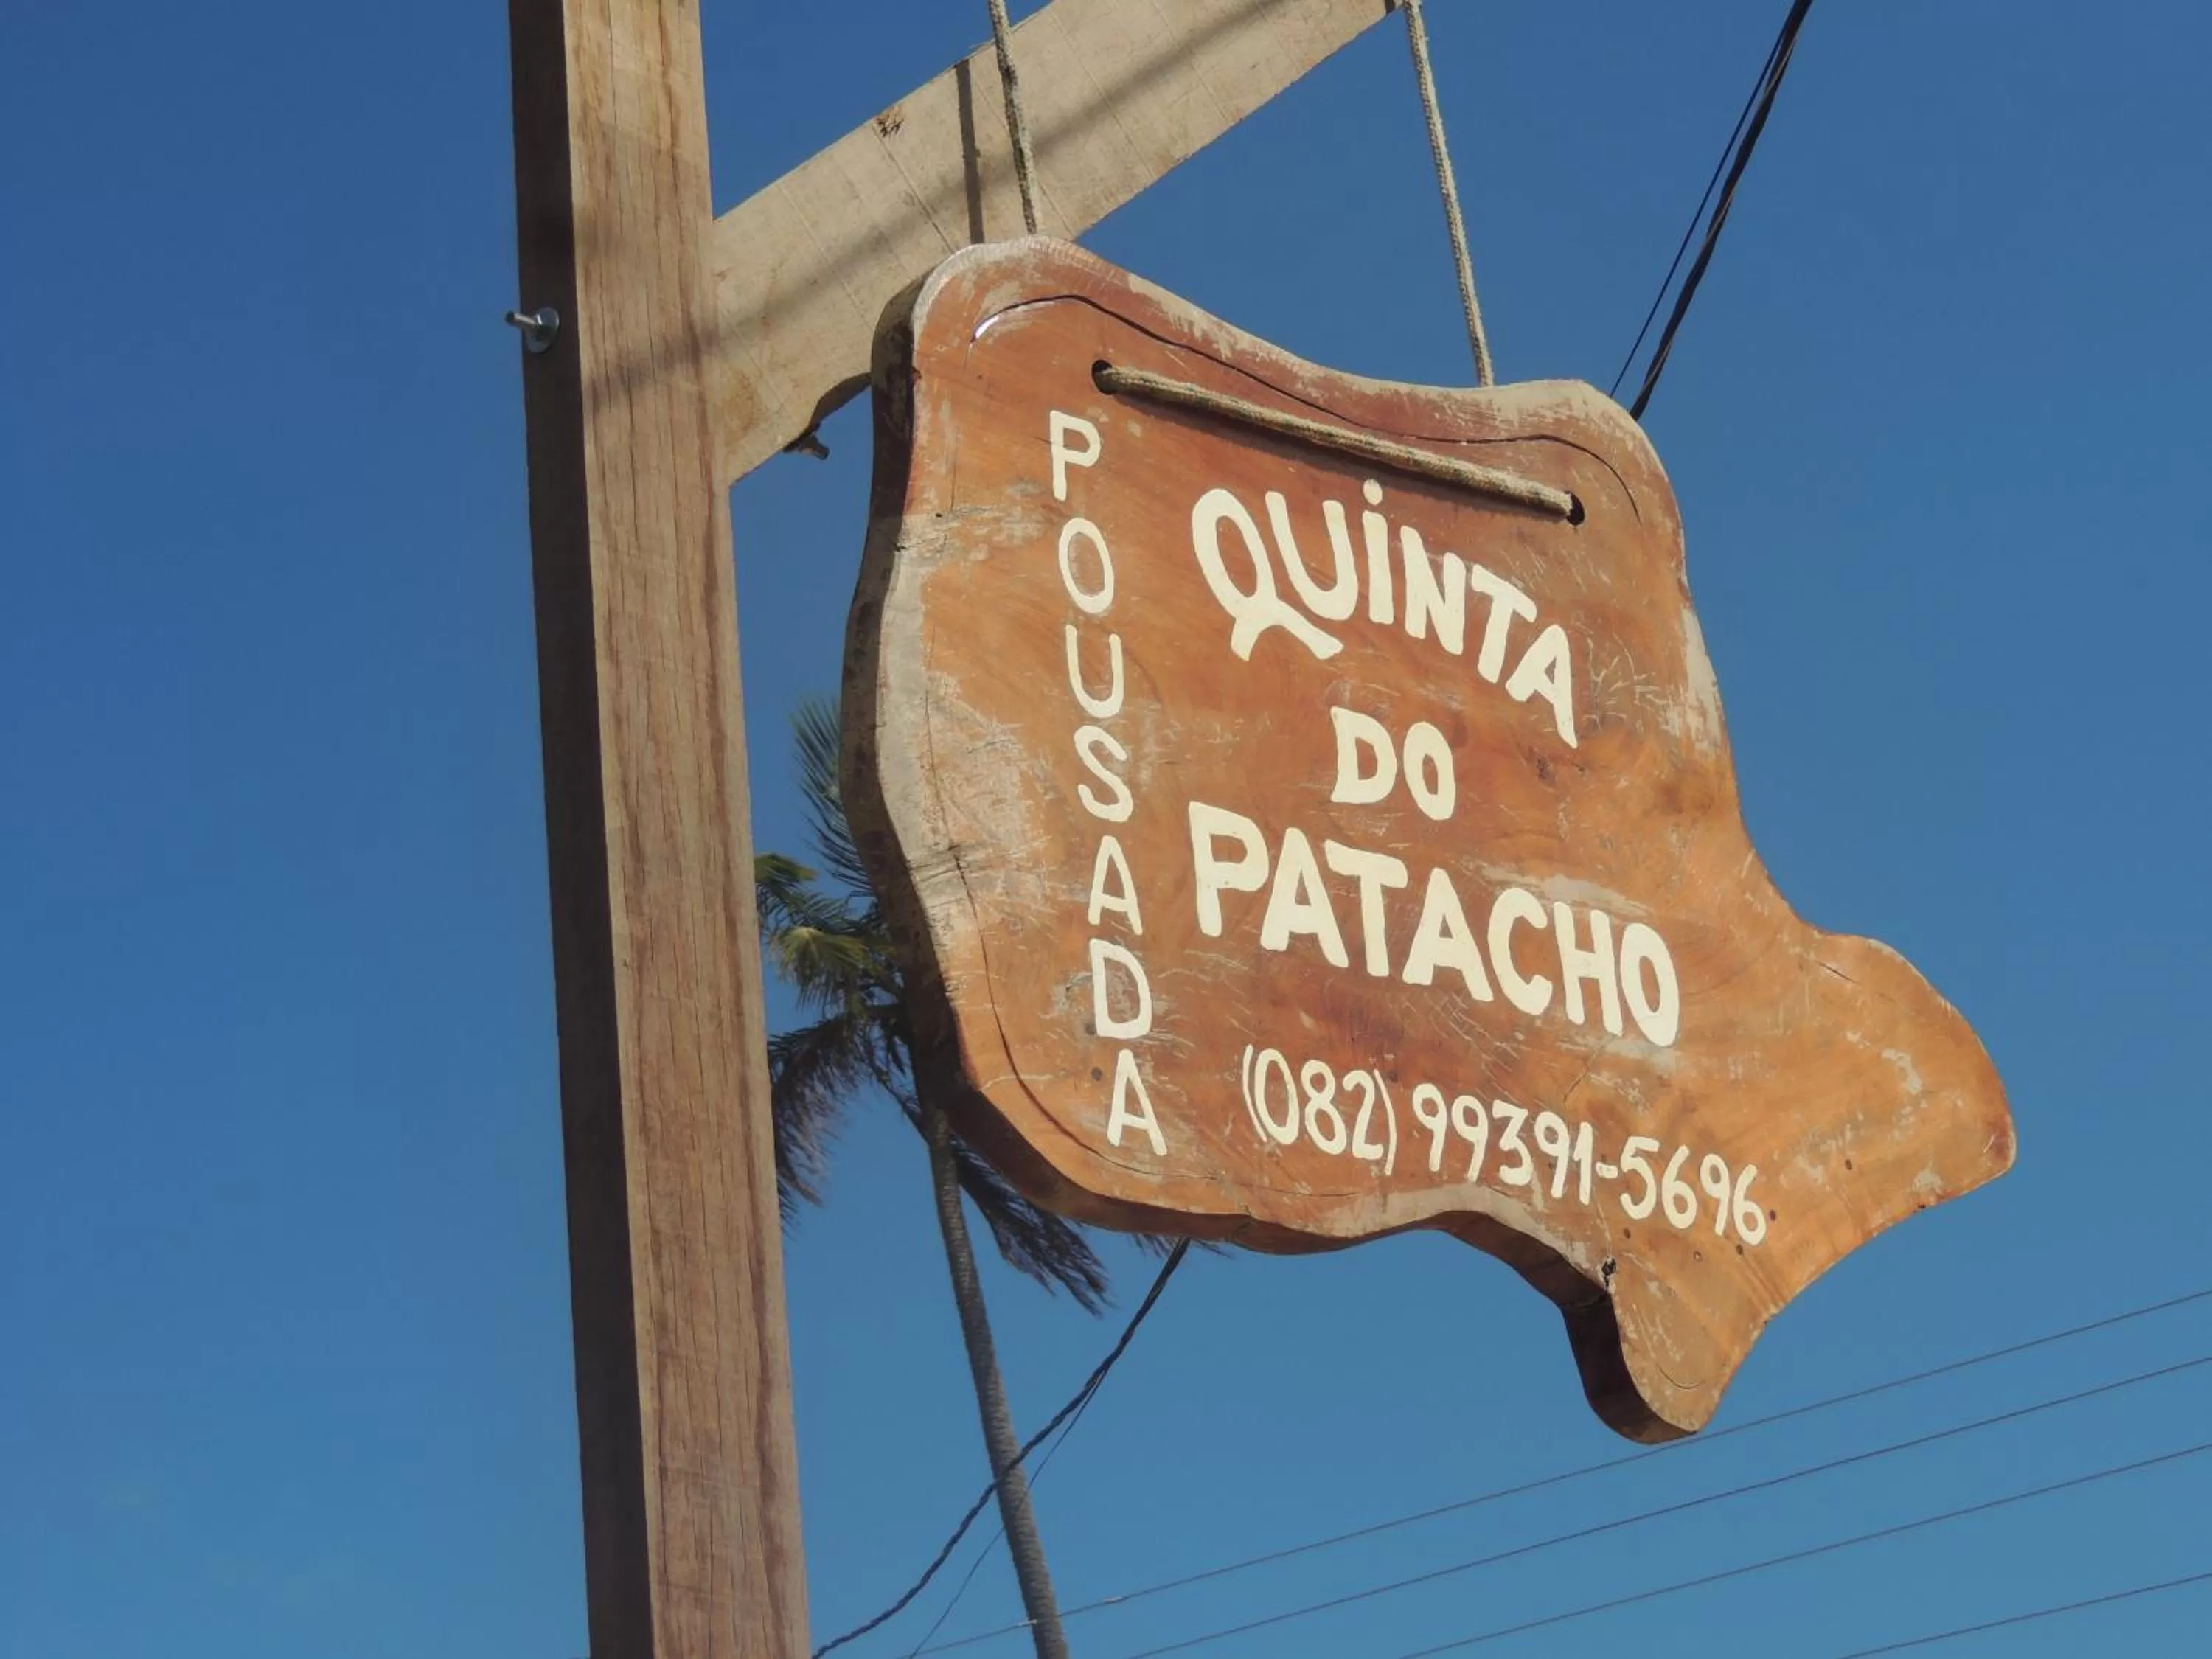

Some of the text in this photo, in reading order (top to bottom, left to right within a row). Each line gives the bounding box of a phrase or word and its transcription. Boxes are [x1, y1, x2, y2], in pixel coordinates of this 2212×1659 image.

[1049, 410, 1168, 1156] POUSADA
[1331, 706, 1456, 821] DO
[1188, 801, 1680, 1047] PATACHO
[1242, 1044, 1767, 1246] (082) 99391-5696
